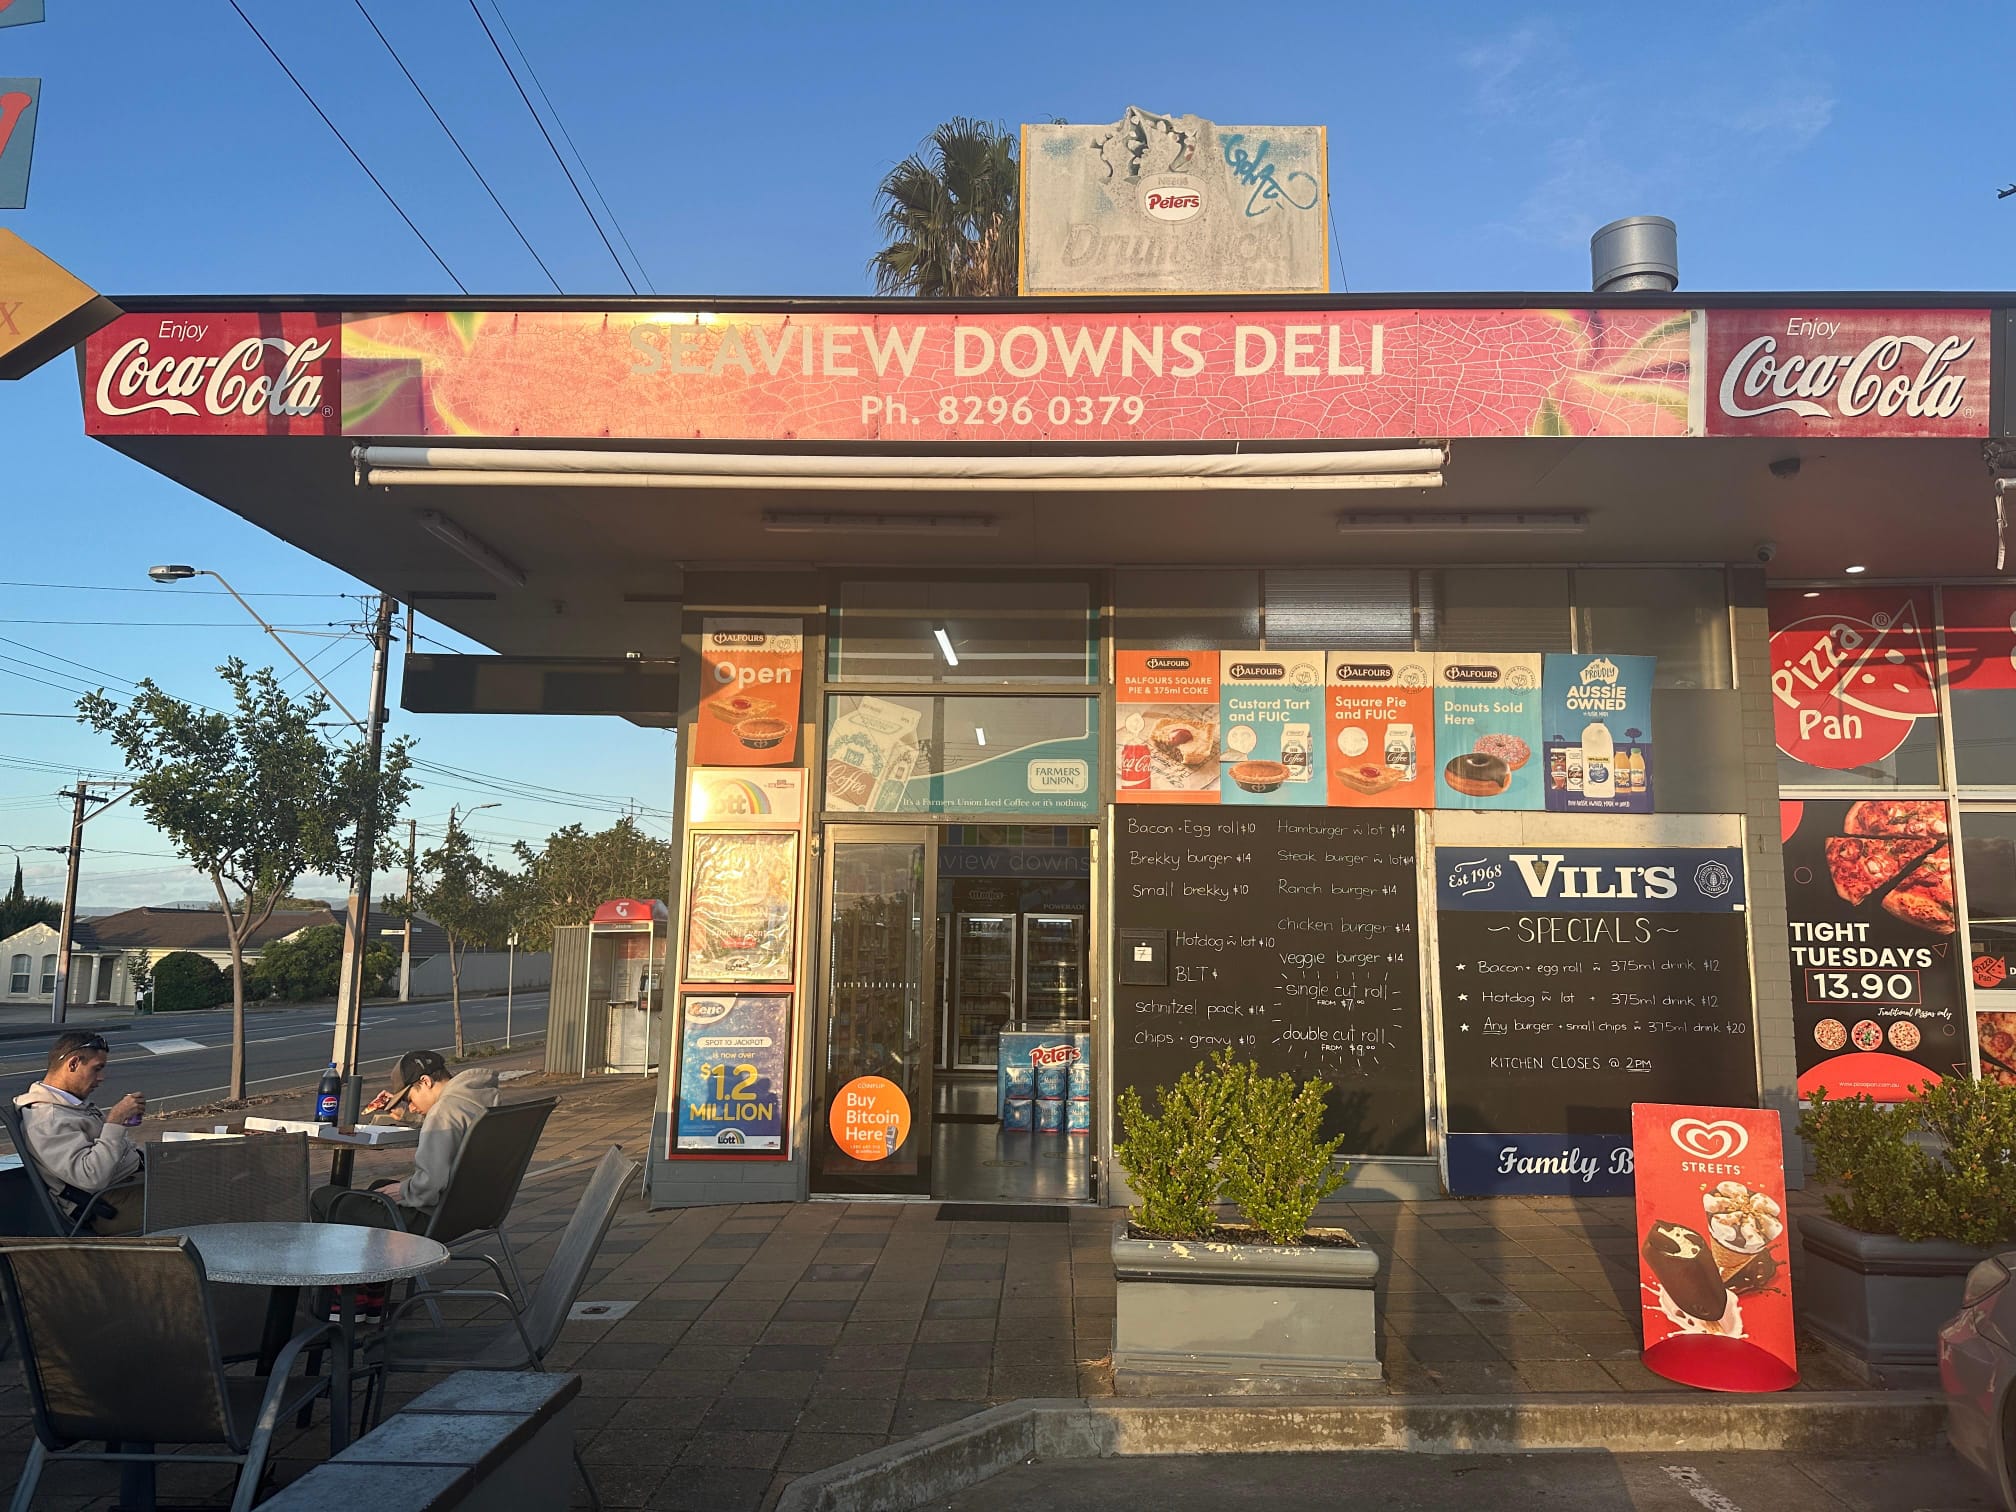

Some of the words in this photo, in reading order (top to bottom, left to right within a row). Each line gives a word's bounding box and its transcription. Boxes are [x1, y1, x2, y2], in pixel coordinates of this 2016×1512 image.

[1148, 193, 1199, 210] Peters
[158, 320, 208, 342] Enjoy
[1786, 318, 1840, 340] Enjoy
[629, 324, 927, 377] SEAVIEW
[954, 325, 1205, 378] DOWNS
[1234, 325, 1385, 377] DELI
[97, 338, 333, 417] Coca-Cola
[1719, 335, 1976, 419] Coca-Cola
[861, 396, 920, 424] Ph.
[938, 395, 1033, 426] 8296
[1048, 396, 1144, 425] 0379
[1146, 657, 1190, 669] BALFOURS
[1231, 664, 1283, 679] BALFOURS
[1338, 665, 1392, 680] BALFOURS
[1771, 622, 1864, 710] Pizza
[714, 661, 792, 688] Open
[1125, 676, 1173, 686] BALFOURS
[1175, 677, 1213, 686] SQUARE
[1445, 666, 1499, 681] BALFOURS
[1128, 687, 1142, 695] PIE
[1144, 687, 1151, 695] &
[1153, 687, 1181, 696] 375ml
[1183, 687, 1209, 696] COKE
[1228, 698, 1281, 710] Custard
[1284, 699, 1311, 710] Tart
[1335, 696, 1383, 709] Square
[1386, 696, 1407, 708] Pie
[1444, 701, 1490, 713] Donuts
[1493, 701, 1524, 714] Sold
[1566, 698, 1627, 711] OWNED
[1228, 711, 1254, 722] and
[1258, 711, 1291, 722] FUIC
[1335, 709, 1361, 720] and
[1364, 709, 1398, 720] FUIC
[1444, 714, 1476, 726] Here
[1799, 708, 1863, 740] Pan
[1035, 767, 1081, 776] FARMERS
[1042, 776, 1074, 785] UNION
[922, 798, 955, 806] Farmers
[957, 798, 982, 807] Union
[984, 798, 1001, 807] Iced
[1003, 798, 1030, 807] Coffee
[1127, 817, 1175, 834] Bacon
[1184, 819, 1212, 838] Egg
[1217, 820, 1239, 836] roll
[1277, 819, 1349, 840] Hamburger
[1367, 823, 1386, 836] lot
[1129, 850, 1181, 871] Brekky
[1187, 847, 1233, 870] burger
[1277, 849, 1318, 862] Steak
[1325, 850, 1369, 867] burger
[1449, 872, 1469, 889] Est
[1471, 863, 1503, 885] 1968
[1508, 854, 1679, 899] VILI'S
[1132, 881, 1174, 898] Small
[1183, 882, 1230, 902] brekky
[1232, 883, 1250, 896] $10
[1278, 878, 1322, 895] Ranch
[1331, 882, 1378, 900] burger
[1381, 884, 1398, 897] $14
[1277, 916, 1334, 932] Chicken
[1340, 916, 1393, 941] burger
[1395, 922, 1411, 934] $14
[1517, 916, 1651, 944] SPECIALS
[1789, 922, 1870, 943] TIGHT
[1175, 929, 1224, 952] Hotdog
[1240, 935, 1257, 948] lot
[1336, 948, 1381, 967] burger
[1386, 952, 1404, 964] $14
[1791, 946, 1933, 968] TUESDAYS
[1175, 965, 1209, 983] BLT
[1477, 960, 1524, 974] Bacon
[1537, 964, 1559, 977] egg
[1563, 962, 1583, 974] roll
[1610, 960, 1656, 973] 375ml
[1660, 959, 1696, 971] drink
[1703, 959, 1721, 973] $12
[1334, 982, 1358, 999] cut
[1364, 983, 1388, 1001] roll
[1813, 973, 1913, 1000] 13.90
[1482, 990, 1535, 1008] Hotdog
[1560, 991, 1575, 1004] lot
[1611, 993, 1656, 1006] 375ml
[1662, 994, 1696, 1007] drink
[1701, 995, 1719, 1008] $12
[1207, 1000, 1244, 1021] pack
[1282, 1023, 1329, 1042] double
[1332, 1023, 1356, 1042] cut
[1361, 1027, 1385, 1045] roll
[1481, 1016, 1508, 1035] Any
[1514, 1018, 1554, 1035] burger
[1566, 1020, 1596, 1032] small
[1598, 1021, 1628, 1034] chips
[1648, 1021, 1688, 1034] 375ml
[1693, 1022, 1721, 1034] drink
[1726, 1020, 1747, 1035] $20
[1134, 1029, 1175, 1048] Chips
[1321, 1043, 1343, 1051] FROM
[1030, 1043, 1081, 1067] Peters
[1490, 1055, 1544, 1070] KITCHEN
[1551, 1056, 1601, 1071] CLOSES
[1608, 1057, 1620, 1069] @
[1625, 1056, 1652, 1070] 2PM
[700, 1063, 758, 1101] $1.2
[846, 1092, 876, 1110] Buy
[690, 1103, 772, 1121] MILLION
[846, 1109, 900, 1125] Bitcoin
[845, 1126, 883, 1141] Here
[1497, 1145, 1601, 1183] Family
[1681, 1161, 1742, 1176] STREETS
